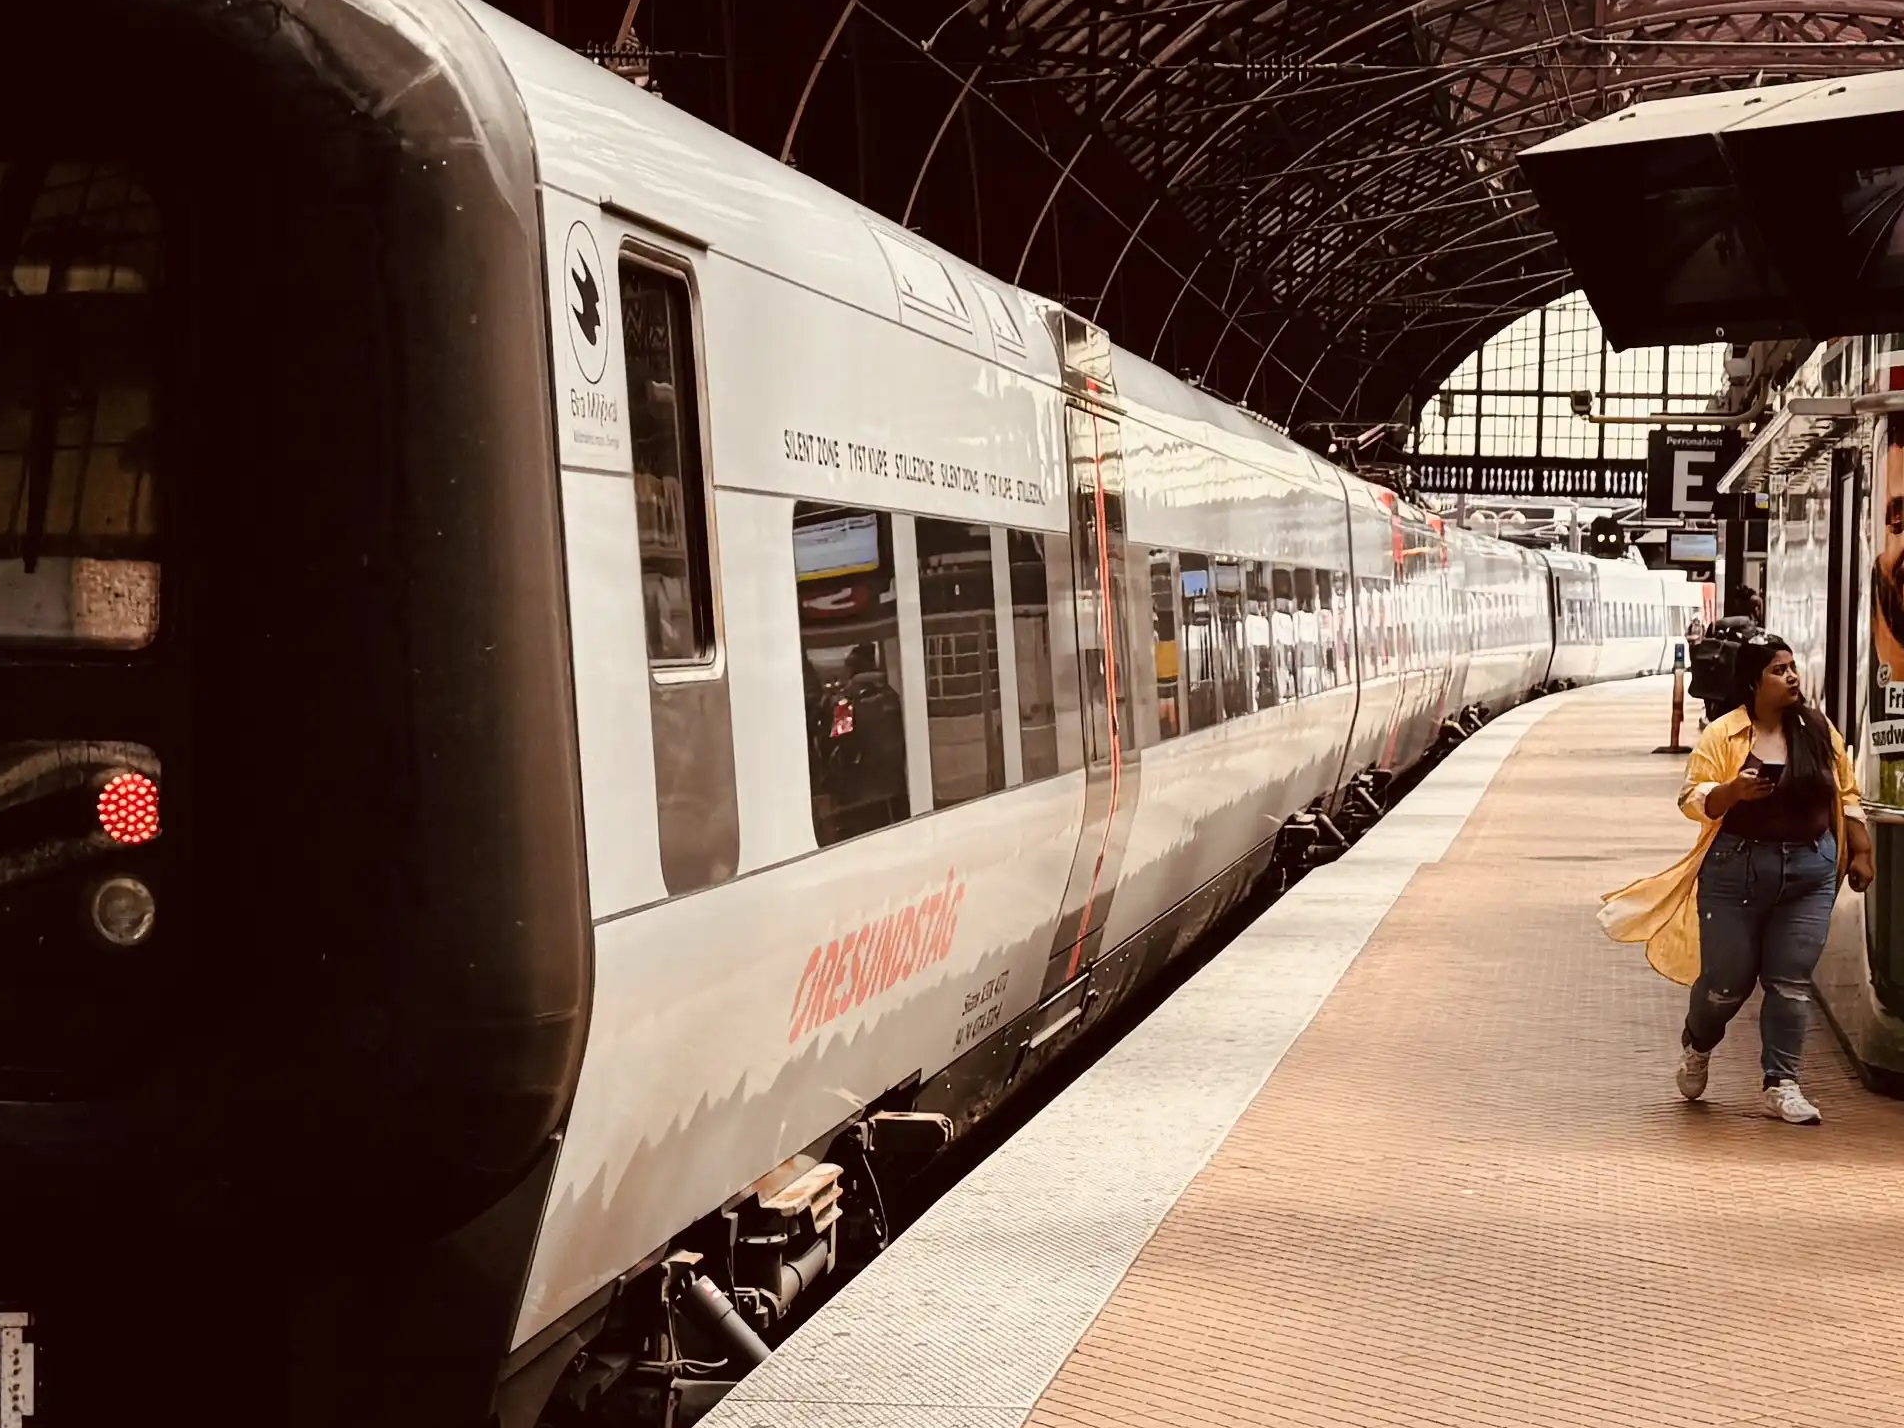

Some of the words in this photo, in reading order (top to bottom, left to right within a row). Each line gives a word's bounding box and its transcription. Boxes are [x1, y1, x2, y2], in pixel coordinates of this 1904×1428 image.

[783, 428, 815, 462] SILENT
[816, 435, 841, 469] ZONE
[1671, 450, 1716, 513] E
